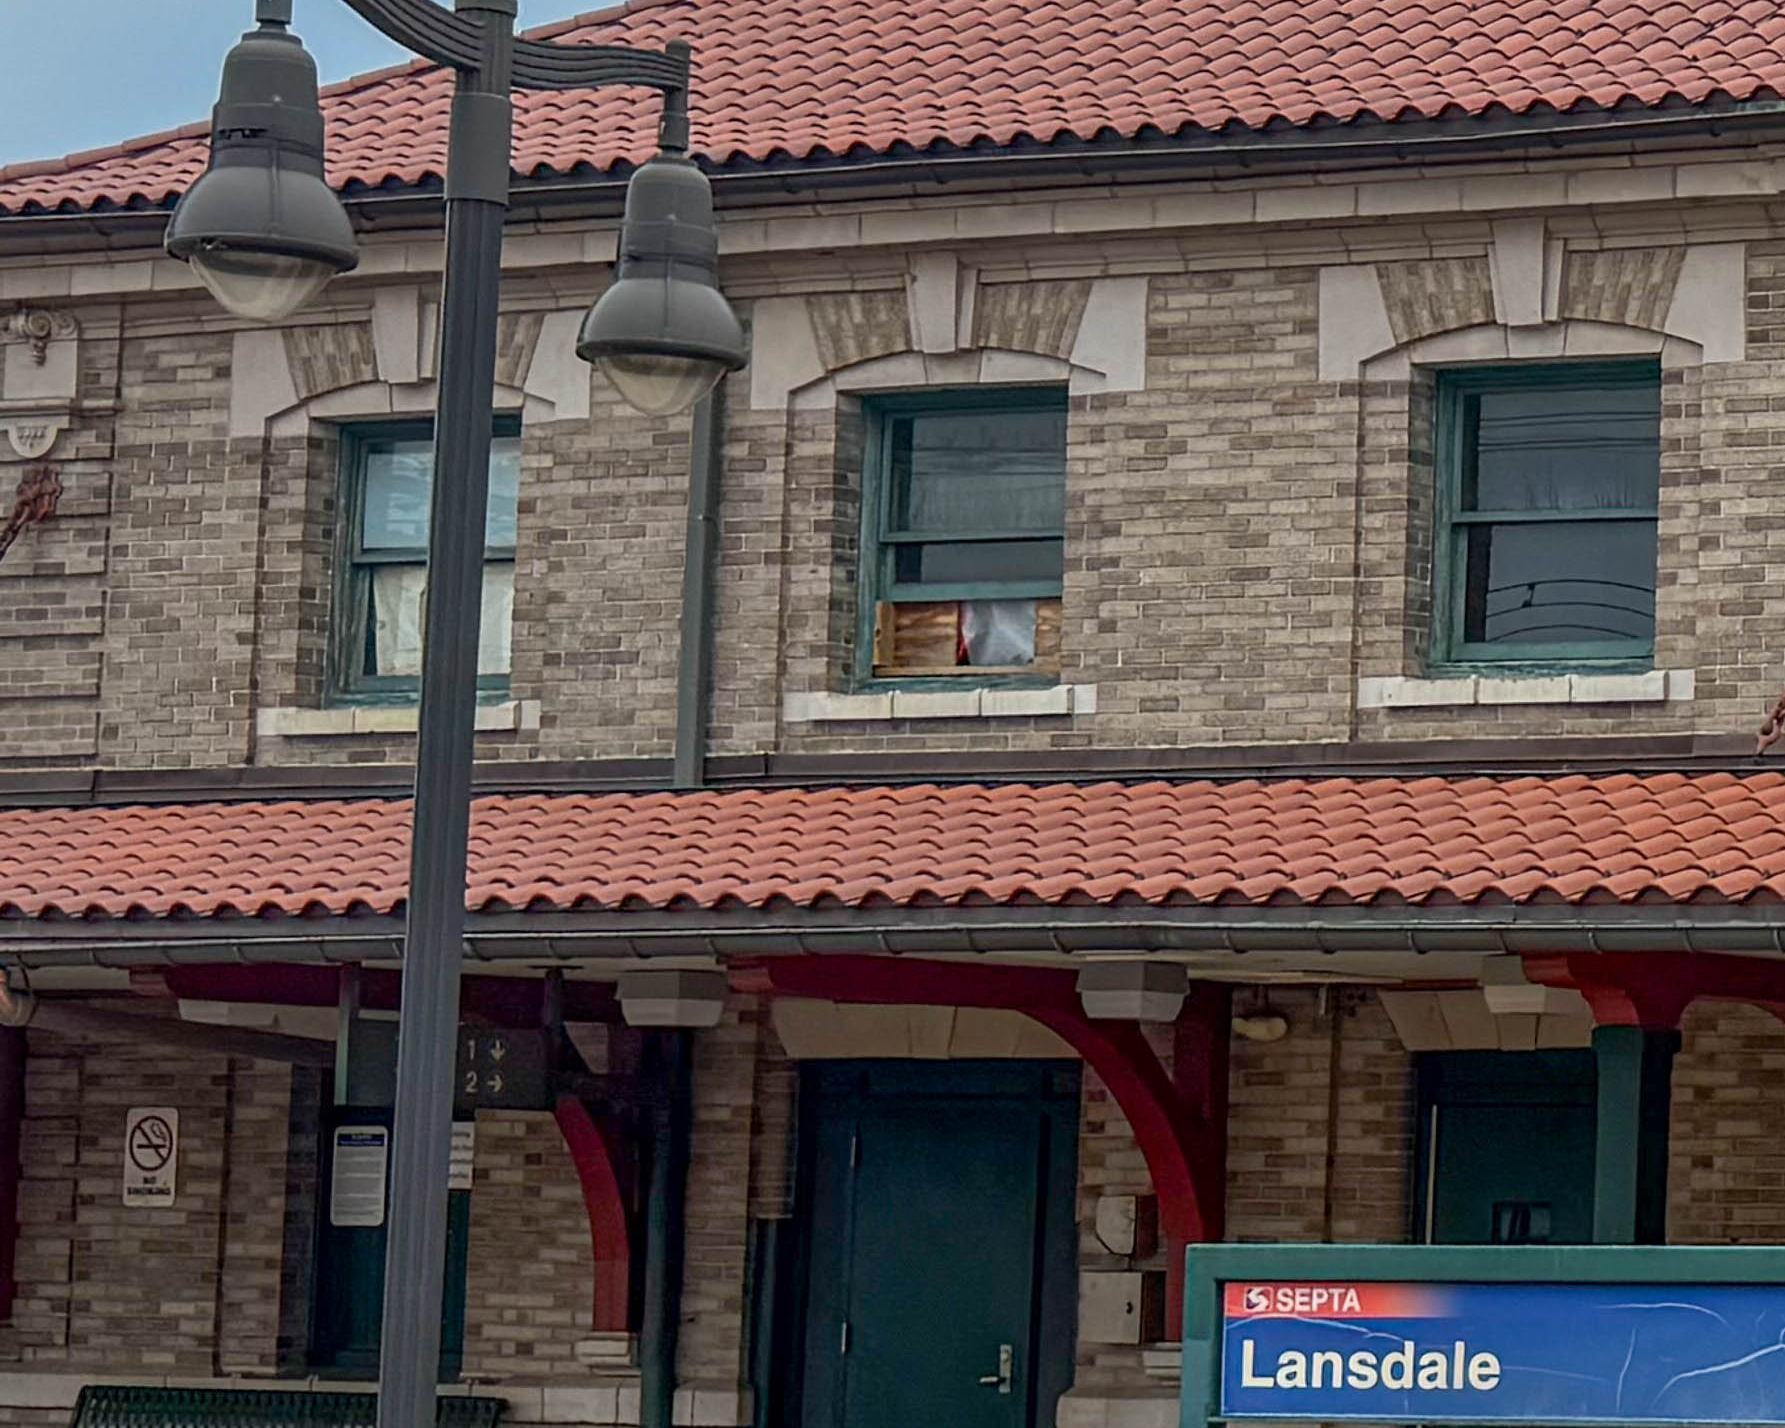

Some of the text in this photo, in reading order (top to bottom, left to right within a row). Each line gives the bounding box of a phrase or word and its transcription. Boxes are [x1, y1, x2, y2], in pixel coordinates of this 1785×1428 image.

[467, 1039, 476, 1060] 1
[464, 1072, 479, 1093] 2
[1276, 1287, 1361, 1312] SEPTA
[1241, 1339, 1501, 1391] Lansdale
